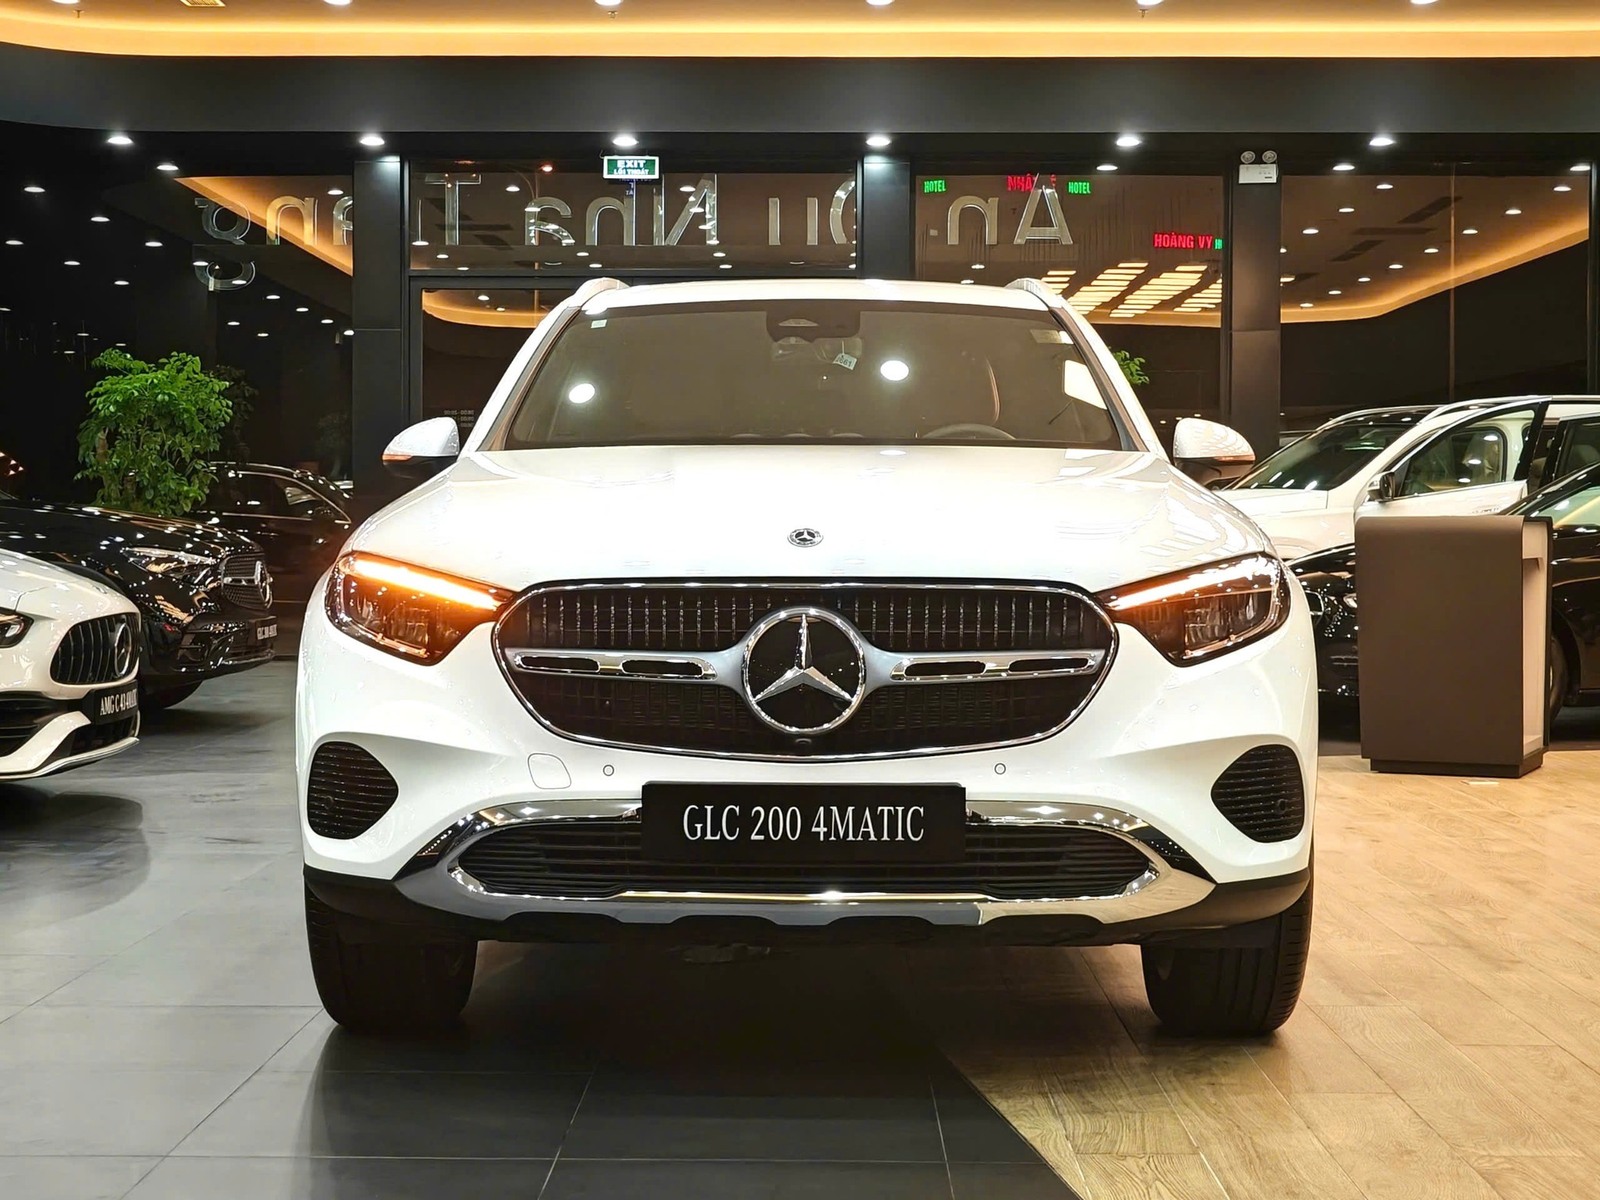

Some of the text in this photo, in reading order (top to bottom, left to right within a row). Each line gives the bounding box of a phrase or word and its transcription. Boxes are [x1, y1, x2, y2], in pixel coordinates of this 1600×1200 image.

[617, 160, 646, 168] EXIT
[923, 179, 946, 193] HOTEL
[1068, 181, 1091, 194] HOTEL
[1154, 232, 1194, 249] HOÀNG
[1198, 235, 1213, 249] VY
[100, 695, 114, 716] AMG
[115, 694, 120, 712] C
[683, 804, 925, 842] GLC 200 4MATIC
